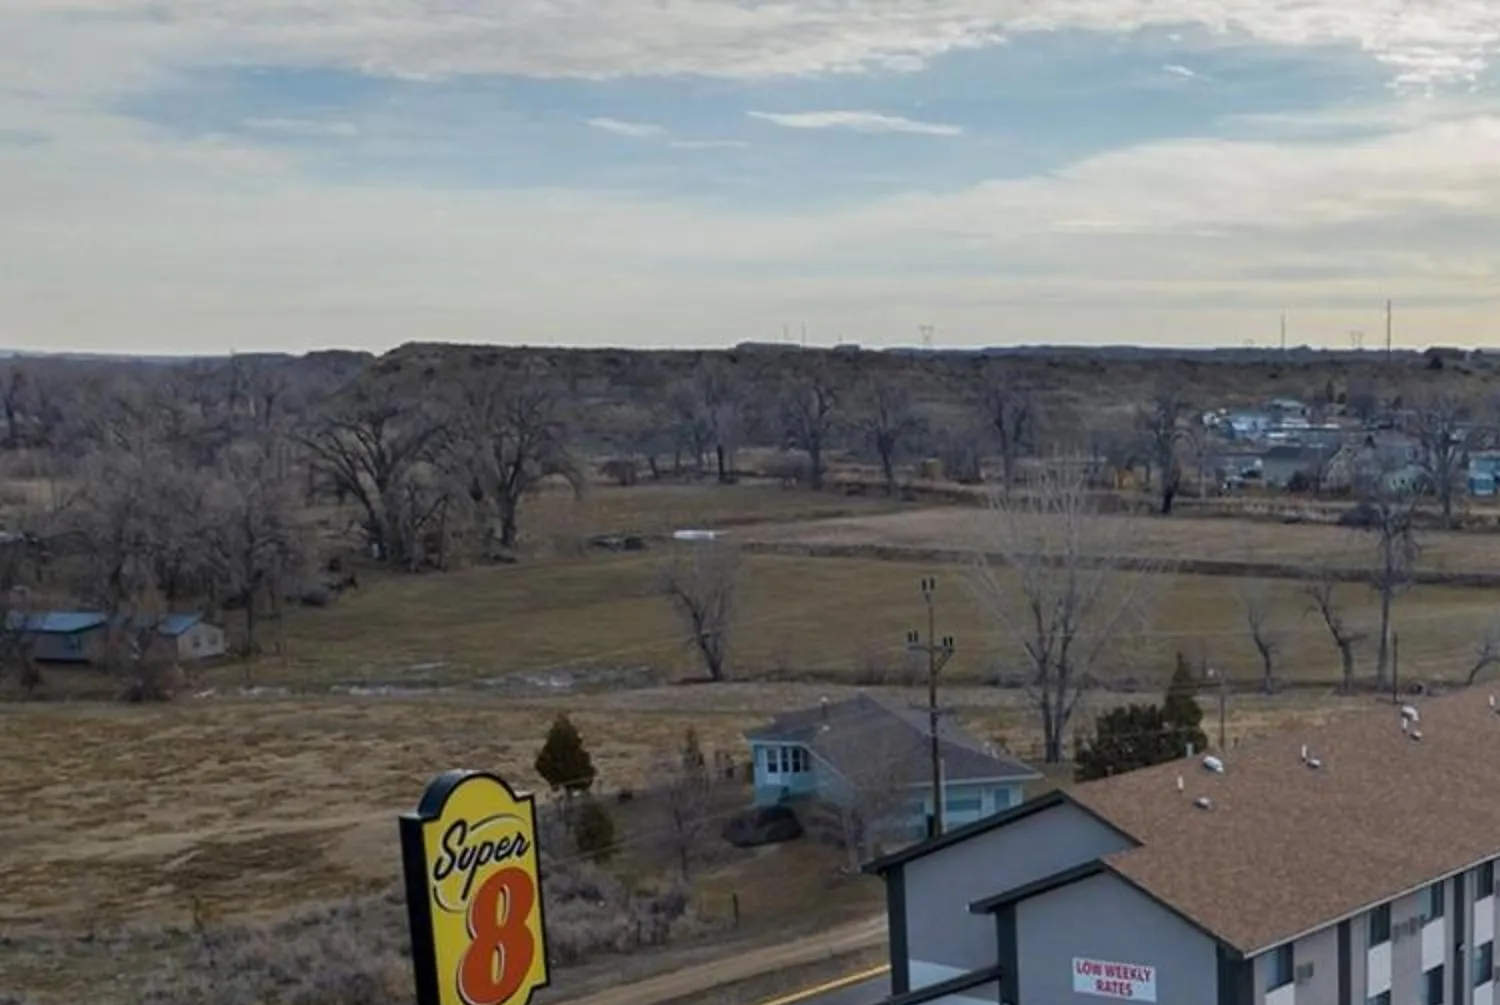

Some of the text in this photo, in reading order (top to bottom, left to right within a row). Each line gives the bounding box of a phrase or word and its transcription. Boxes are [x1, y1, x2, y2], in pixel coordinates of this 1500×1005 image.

[433, 819, 531, 900] Super
[1075, 961, 1152, 982] LOW WEEKLY
[1096, 979, 1133, 997] RATES
